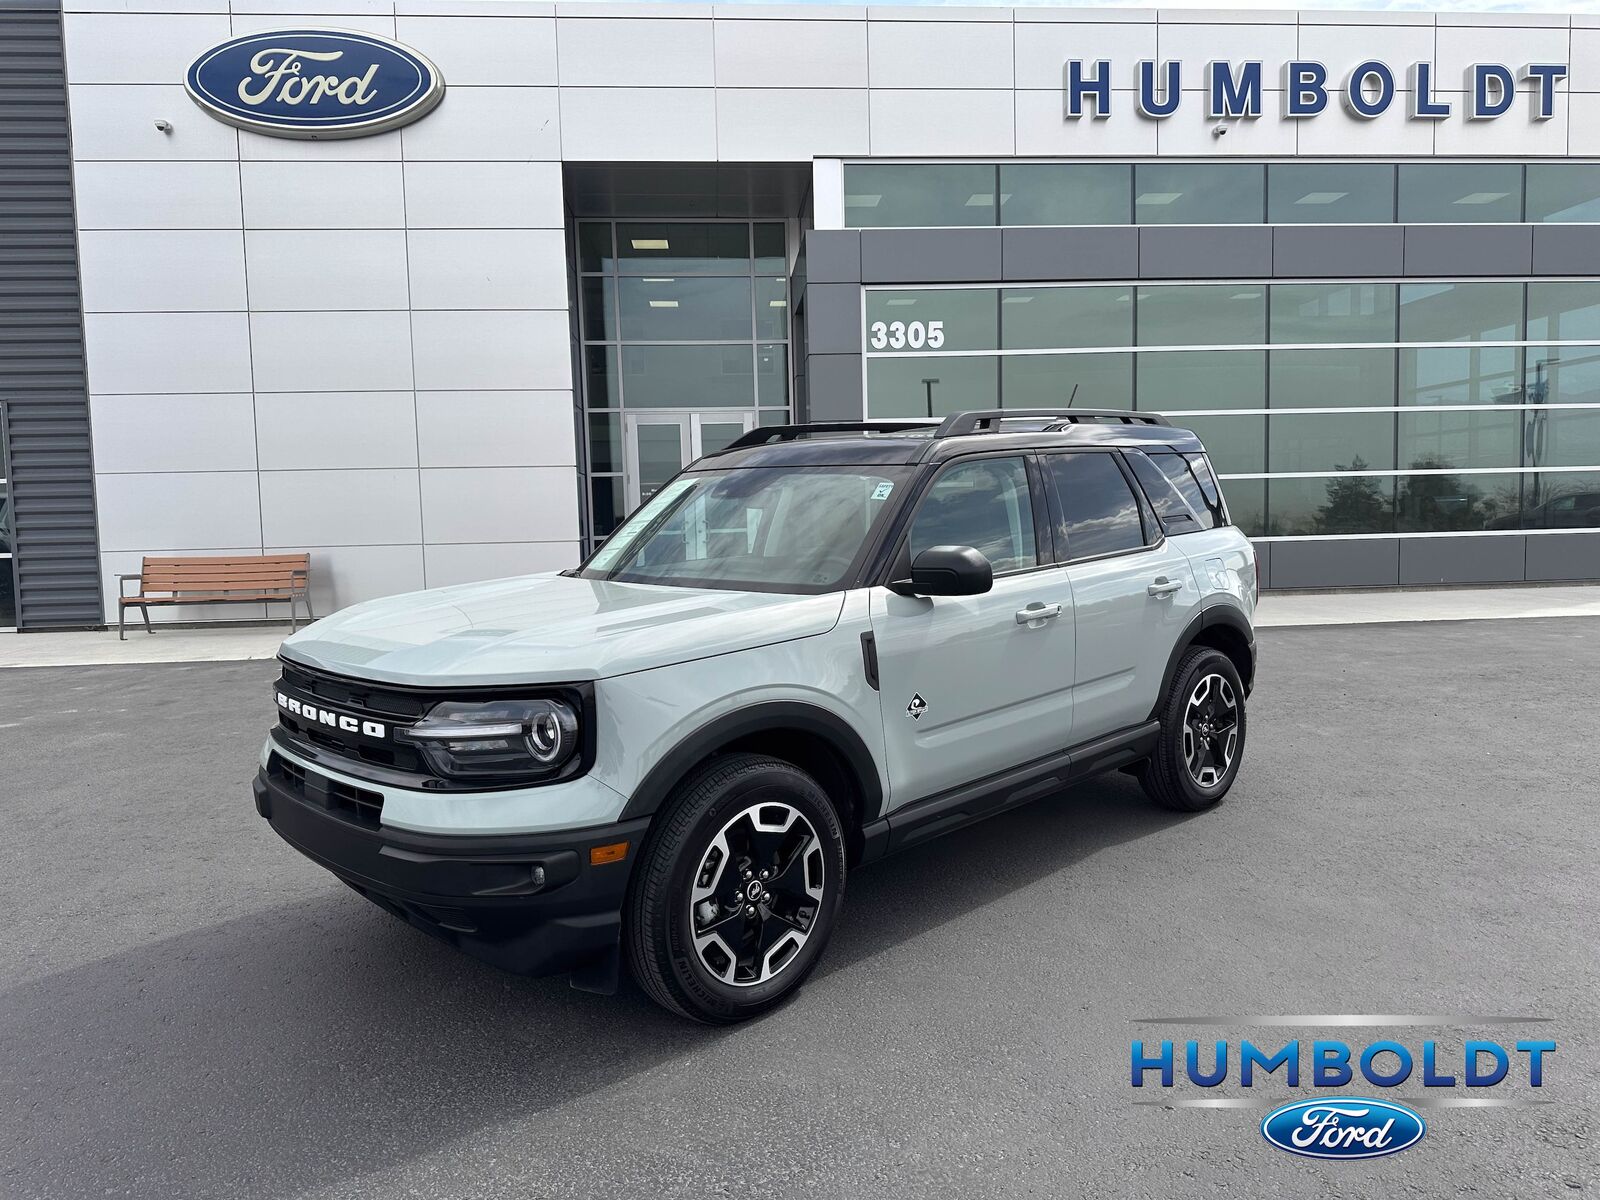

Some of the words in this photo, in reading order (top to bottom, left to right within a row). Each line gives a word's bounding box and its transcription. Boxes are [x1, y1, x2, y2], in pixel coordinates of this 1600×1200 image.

[238, 48, 380, 105] Ford
[1065, 59, 1569, 121] HUMBOLDT
[871, 321, 944, 349] 3305
[277, 692, 385, 738] BRONCO
